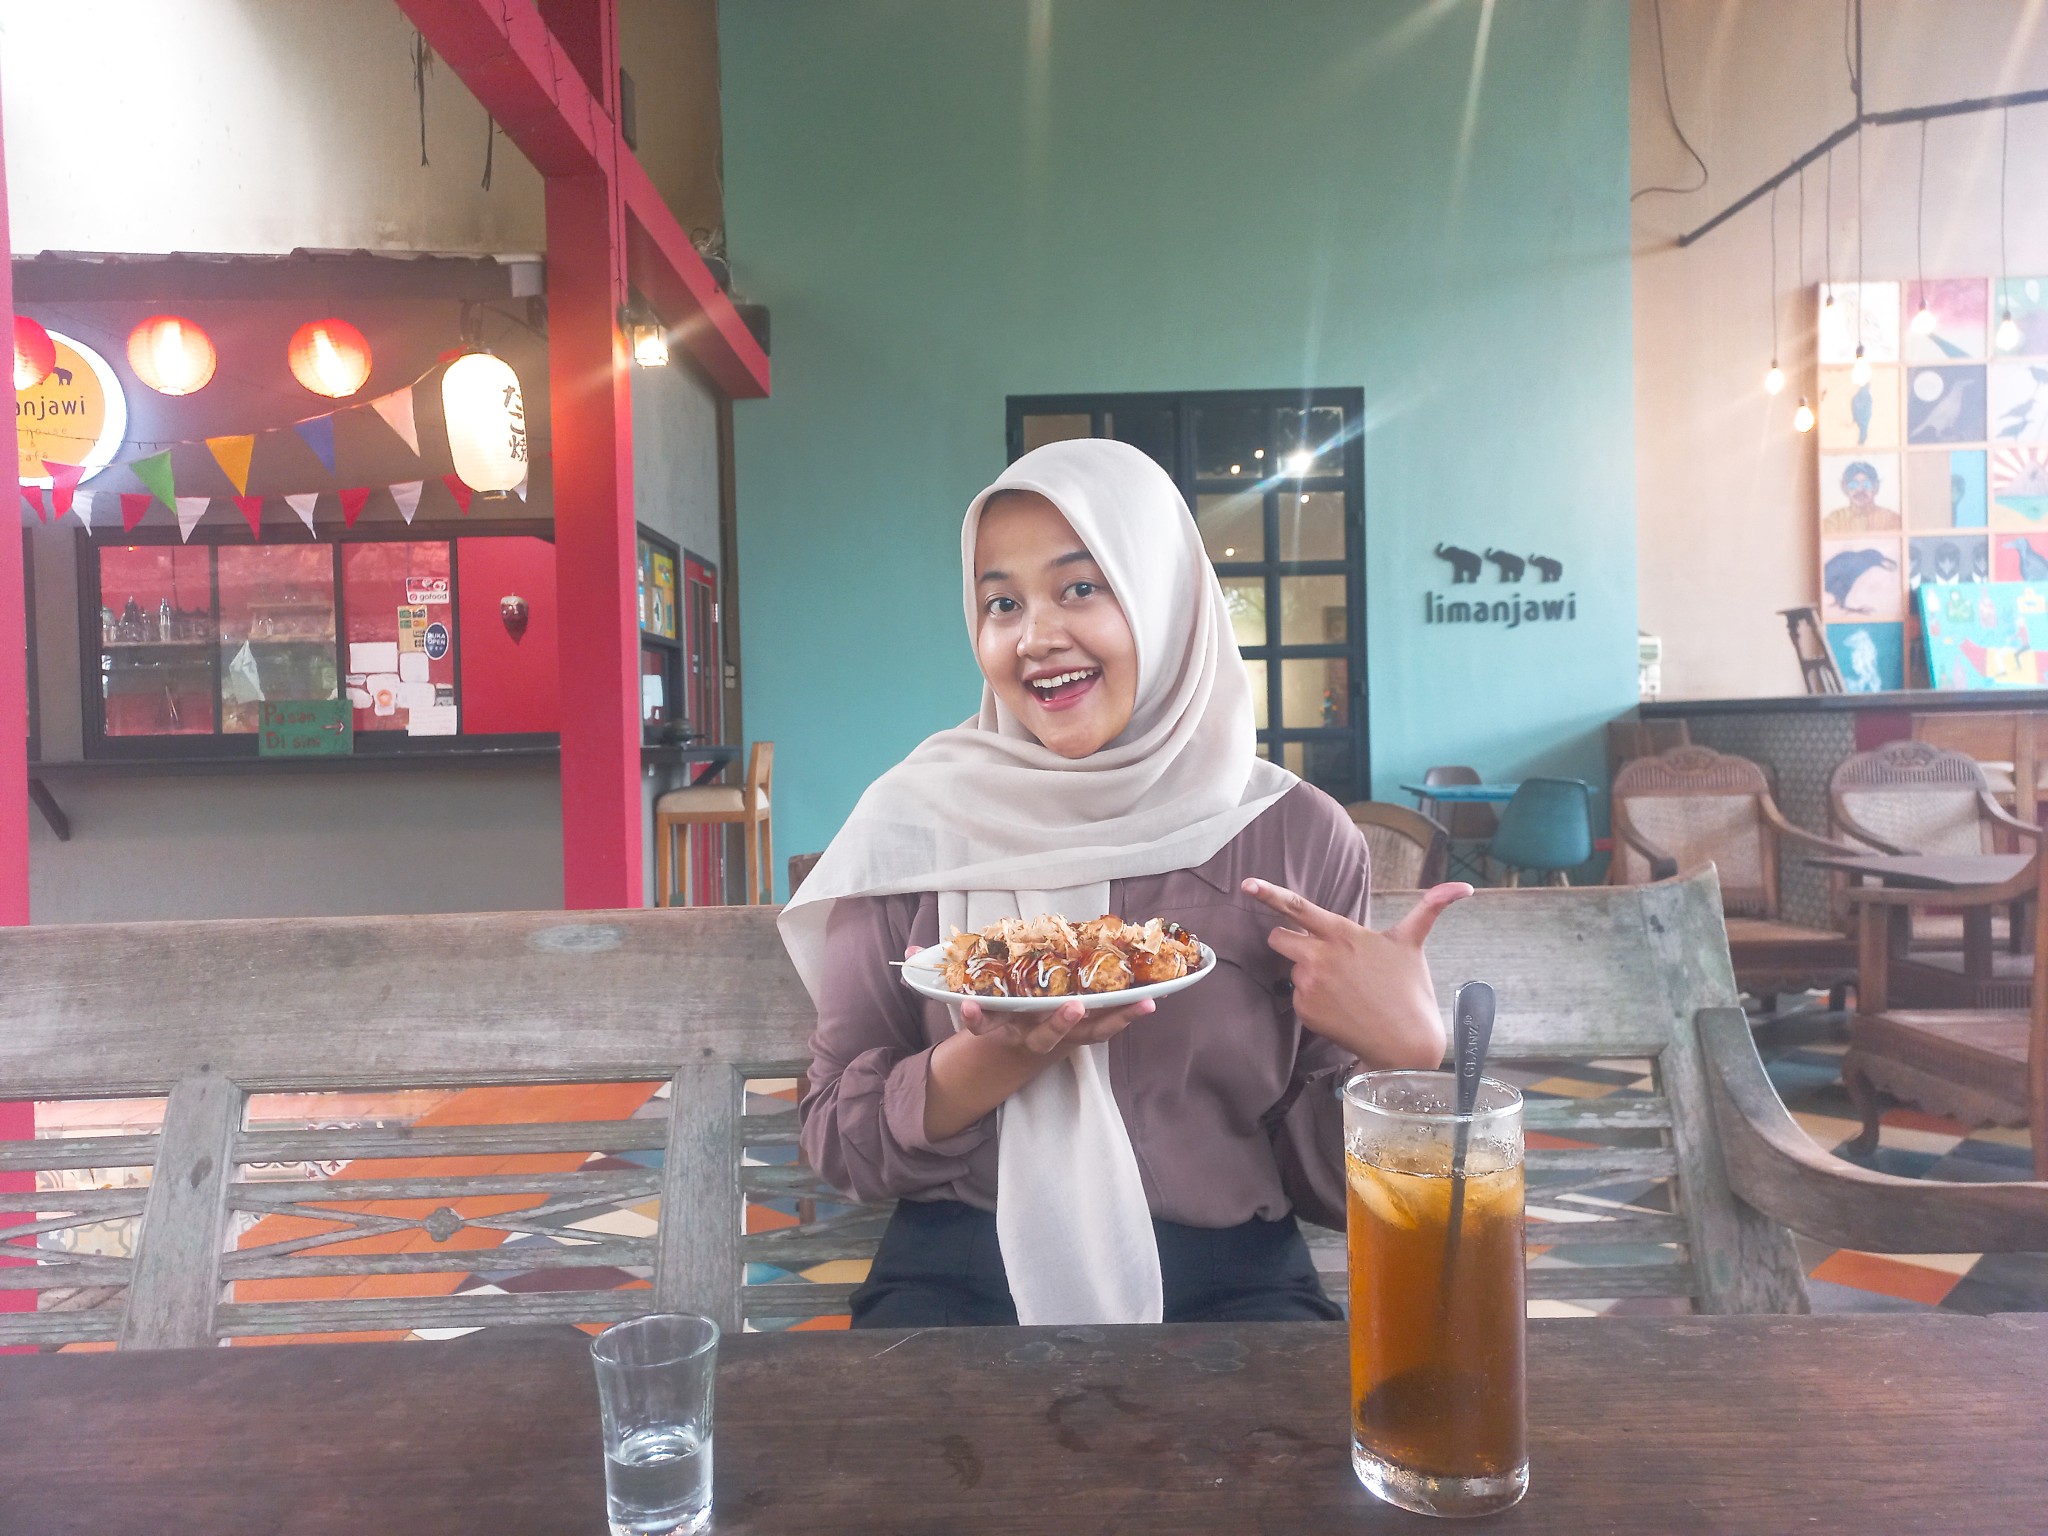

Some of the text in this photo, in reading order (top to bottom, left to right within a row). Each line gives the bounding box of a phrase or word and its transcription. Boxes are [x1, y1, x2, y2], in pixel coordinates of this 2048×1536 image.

[419, 592, 448, 602] gofood
[1425, 591, 1577, 629] limanjawi
[427, 638, 446, 646] OPEN
[264, 703, 316, 725] Pesan
